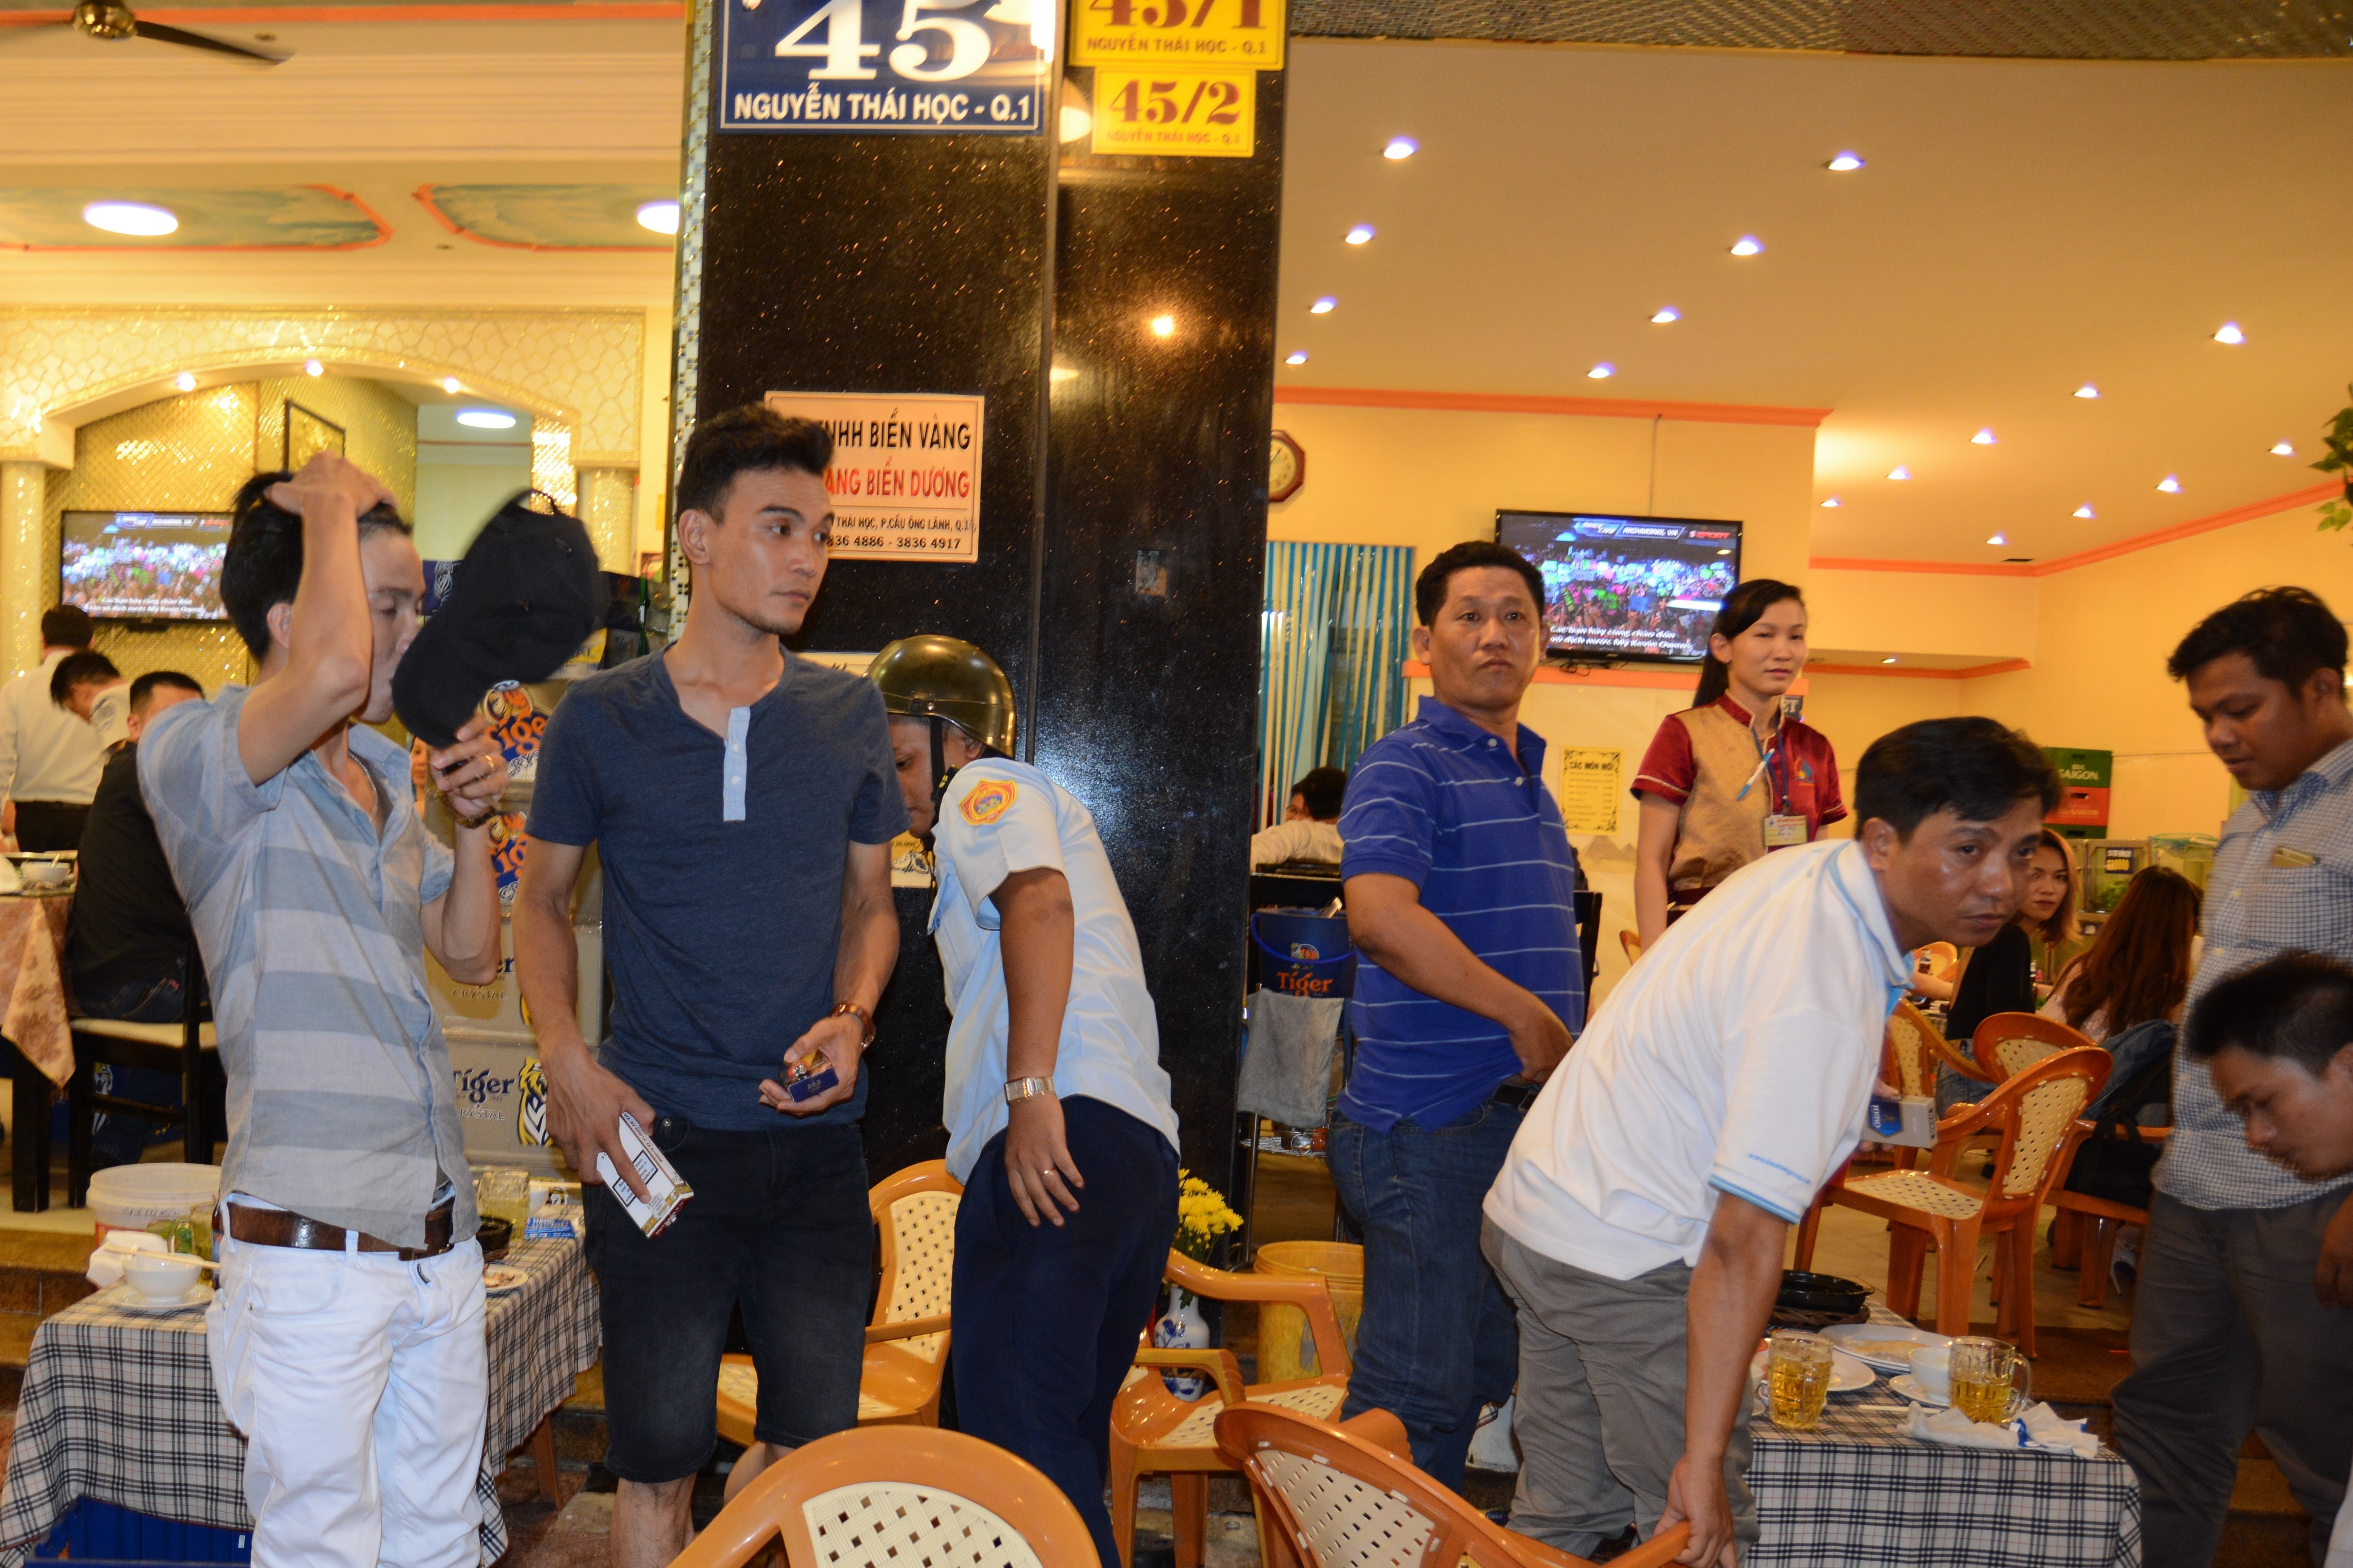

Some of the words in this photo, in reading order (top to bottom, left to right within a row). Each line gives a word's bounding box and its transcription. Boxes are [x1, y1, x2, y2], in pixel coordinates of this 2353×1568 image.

[775, 0, 991, 81] 45
[1087, 33, 1149, 51] NGUYỄN
[1153, 35, 1190, 52] THÁI
[1194, 39, 1227, 55] HỌC
[734, 81, 840, 120] NGUYỄN
[847, 87, 907, 120] THÁI
[913, 93, 969, 124] HỌC
[991, 93, 1030, 122] Q.1
[1108, 79, 1241, 125] 45/2
[1107, 128, 1153, 142] NGUYỄN
[1156, 129, 1183, 143] THÁI
[1187, 131, 1212, 144] HỌC
[919, 413, 971, 450] VÀNG
[911, 466, 971, 498] DƯƠNG
[836, 513, 855, 528] THÁI
[908, 515, 925, 529] ÔNG
[854, 536, 884, 547] 4886
[897, 537, 927, 548] 3836
[931, 538, 961, 549] 4917
[1277, 971, 1333, 997] Tiger
[460, 1107, 505, 1121] RYSTAL
[1873, 1104, 1881, 1128] HERO
